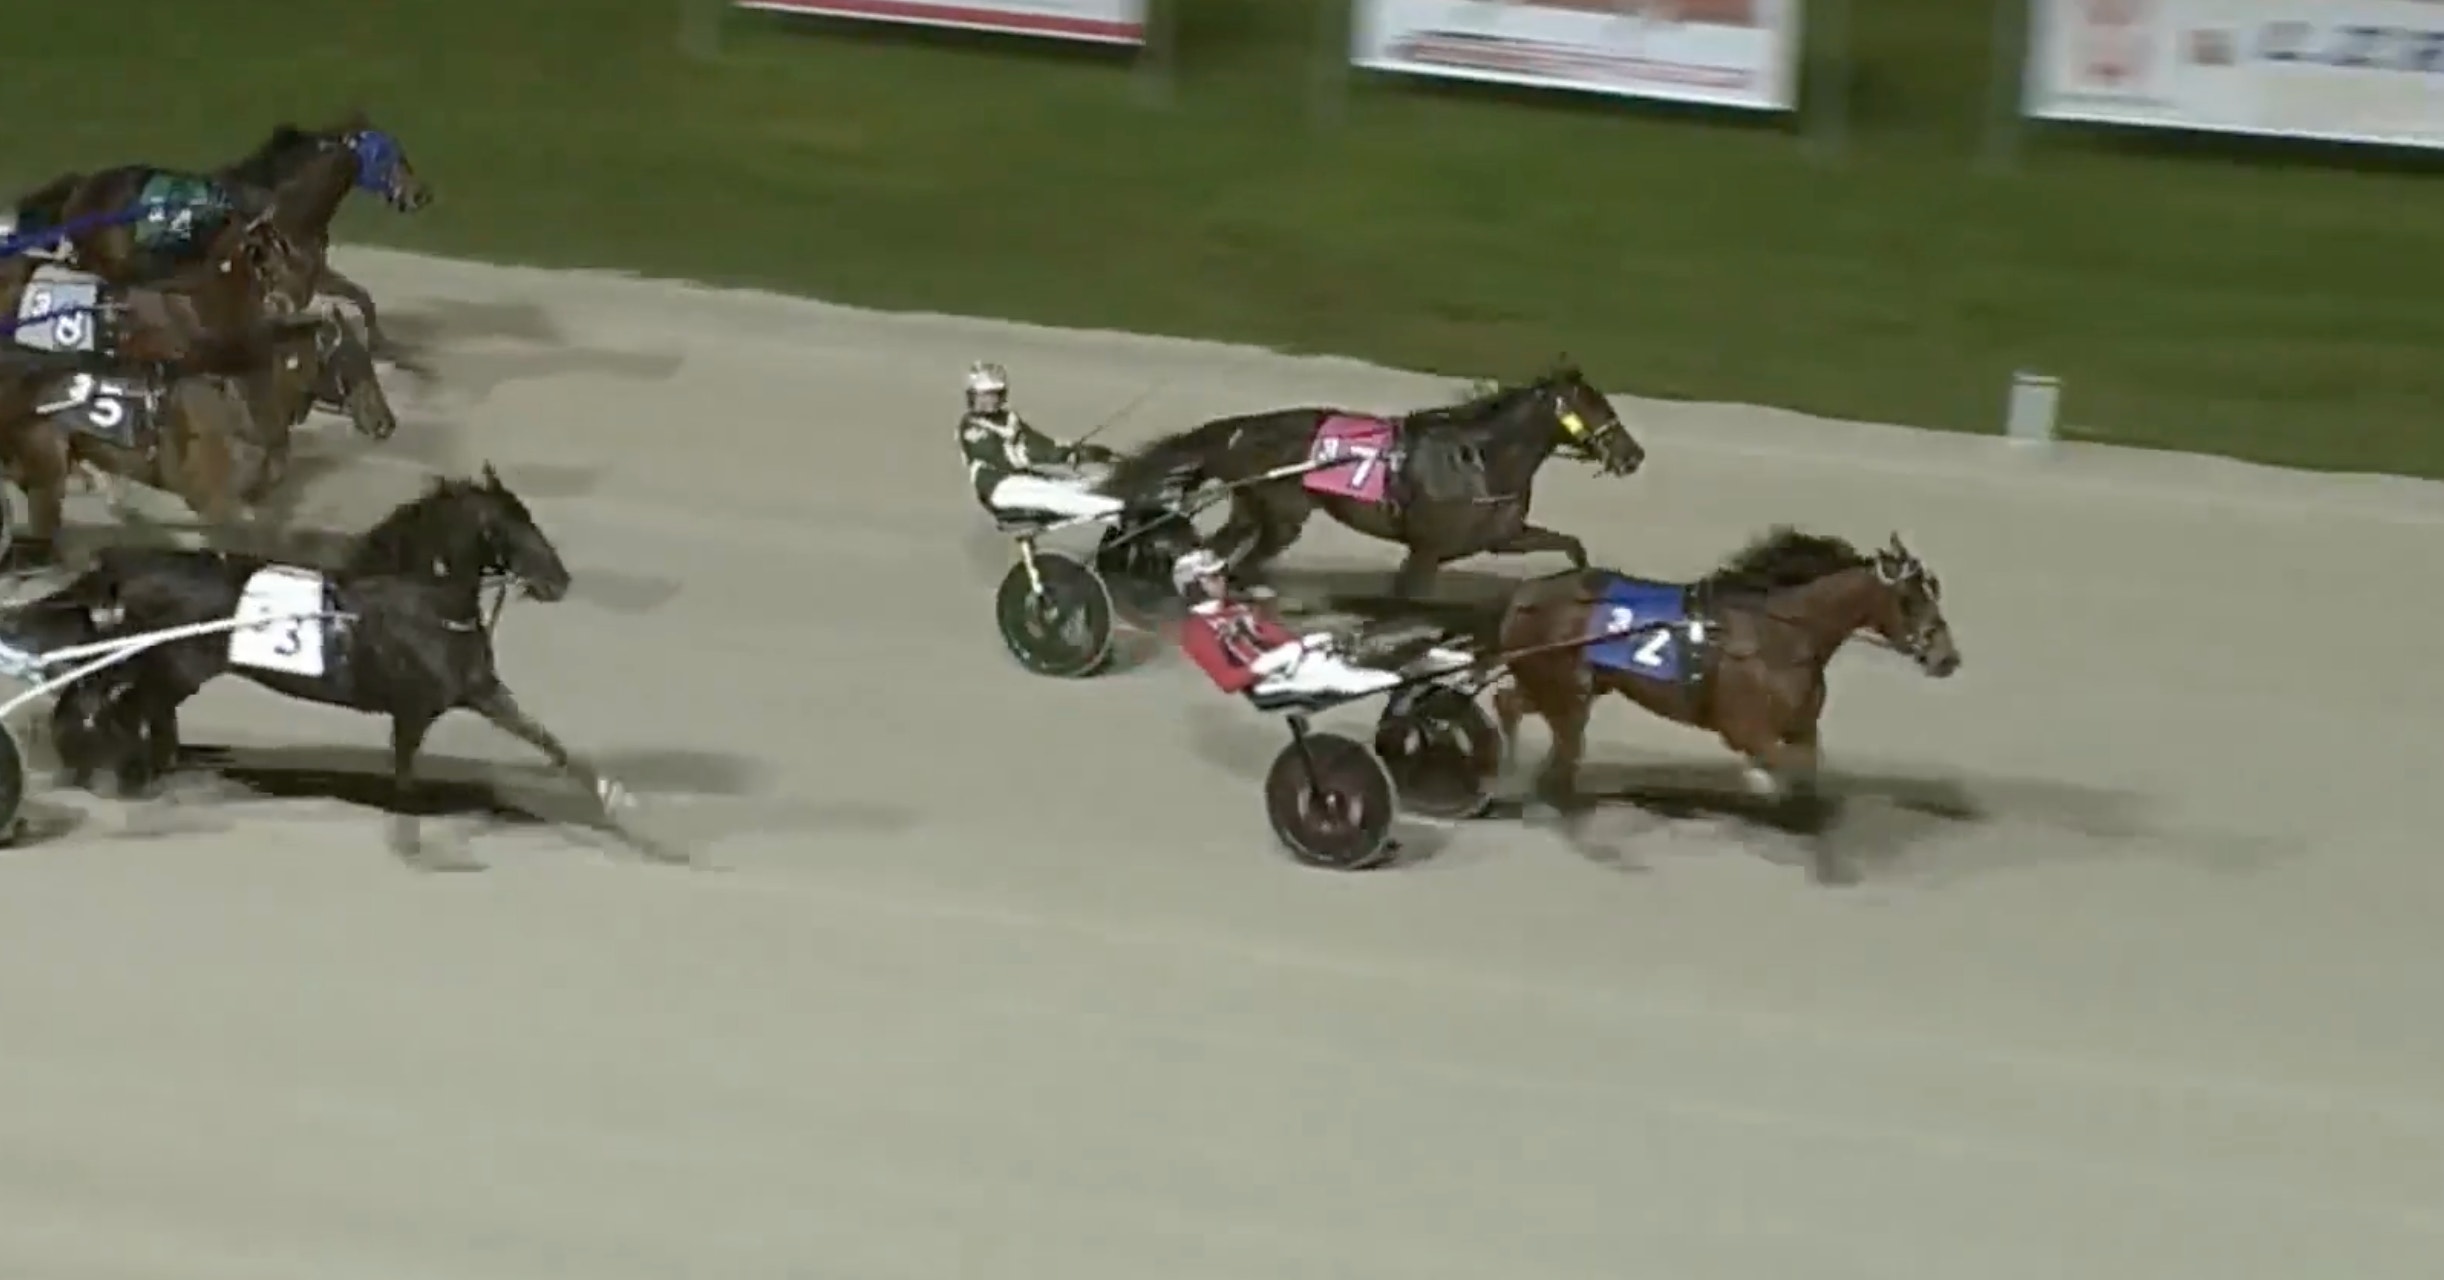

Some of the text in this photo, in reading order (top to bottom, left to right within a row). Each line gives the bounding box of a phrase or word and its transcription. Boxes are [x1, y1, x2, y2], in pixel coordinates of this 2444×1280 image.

[89, 380, 123, 427] 5
[1349, 445, 1378, 487] 7
[1607, 606, 1633, 633] 3
[1632, 624, 1671, 666] 2
